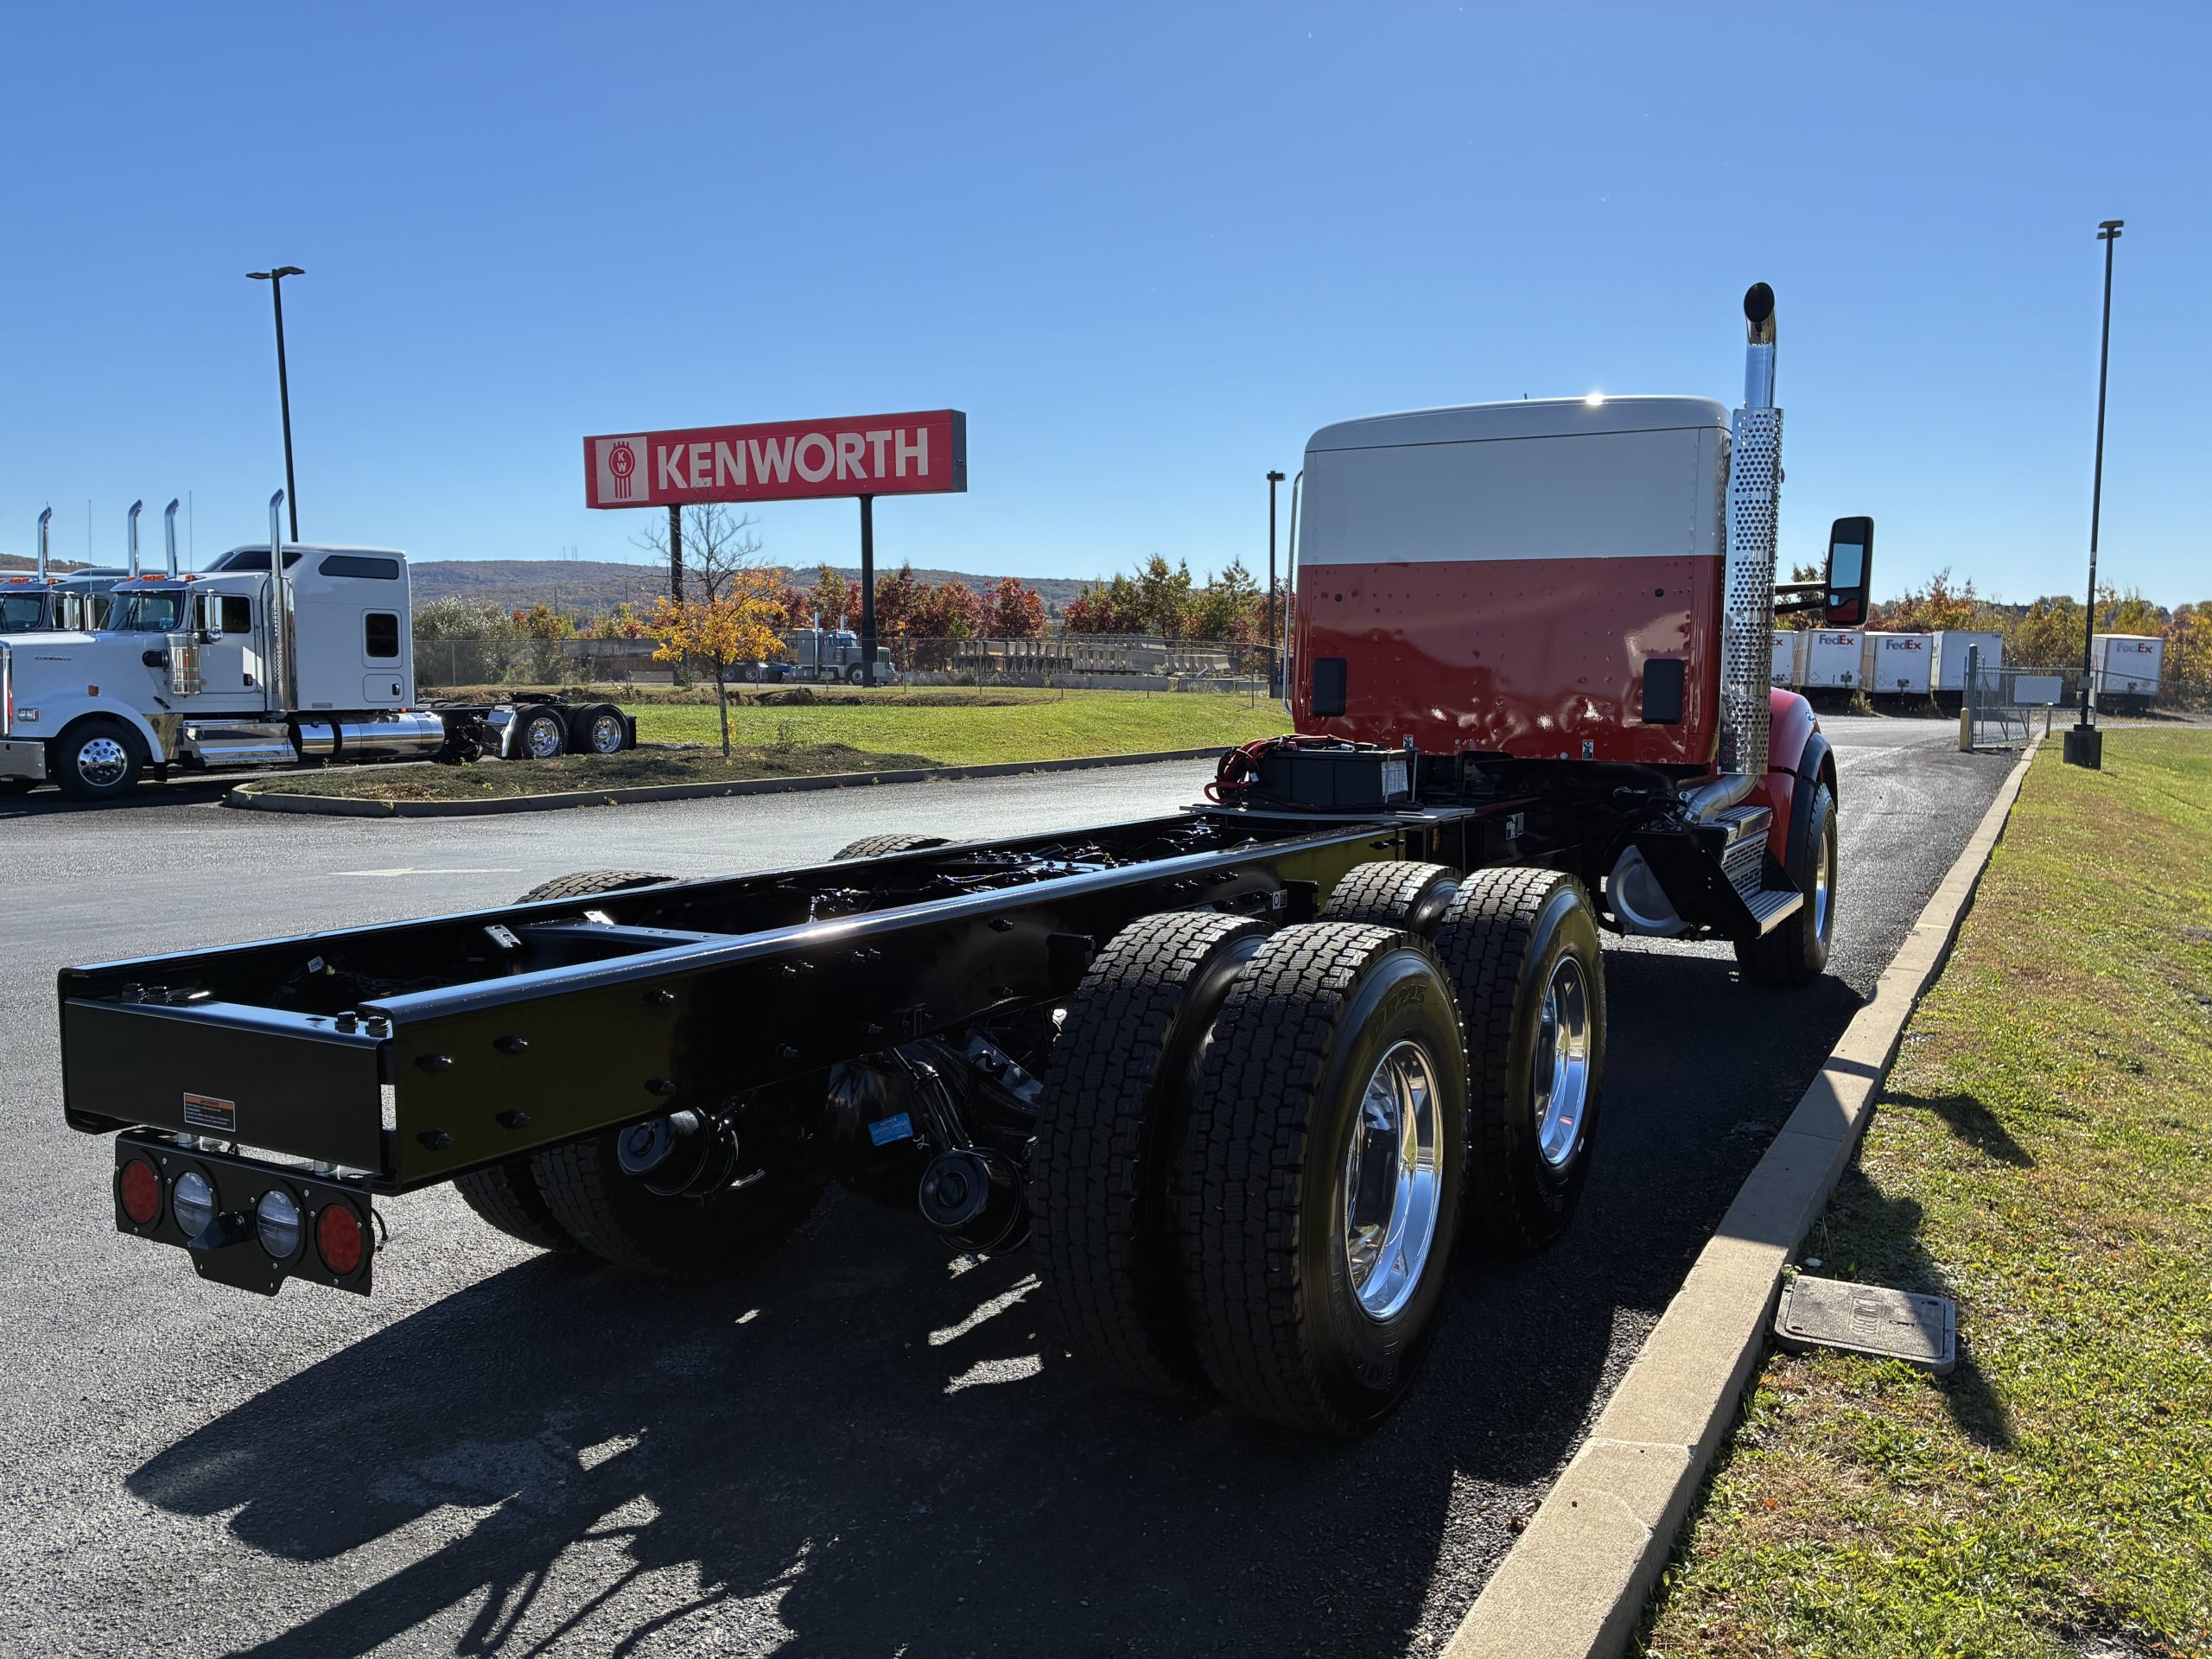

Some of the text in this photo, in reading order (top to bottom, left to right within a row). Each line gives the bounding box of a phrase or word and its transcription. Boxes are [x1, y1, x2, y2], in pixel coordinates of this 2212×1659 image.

[618, 451, 626, 461] K
[658, 428, 928, 489] KENWORTH
[617, 461, 626, 472] W
[1819, 633, 1854, 645] FedEx
[1885, 639, 1923, 651] FedEx
[2116, 642, 2153, 654] FedEx
